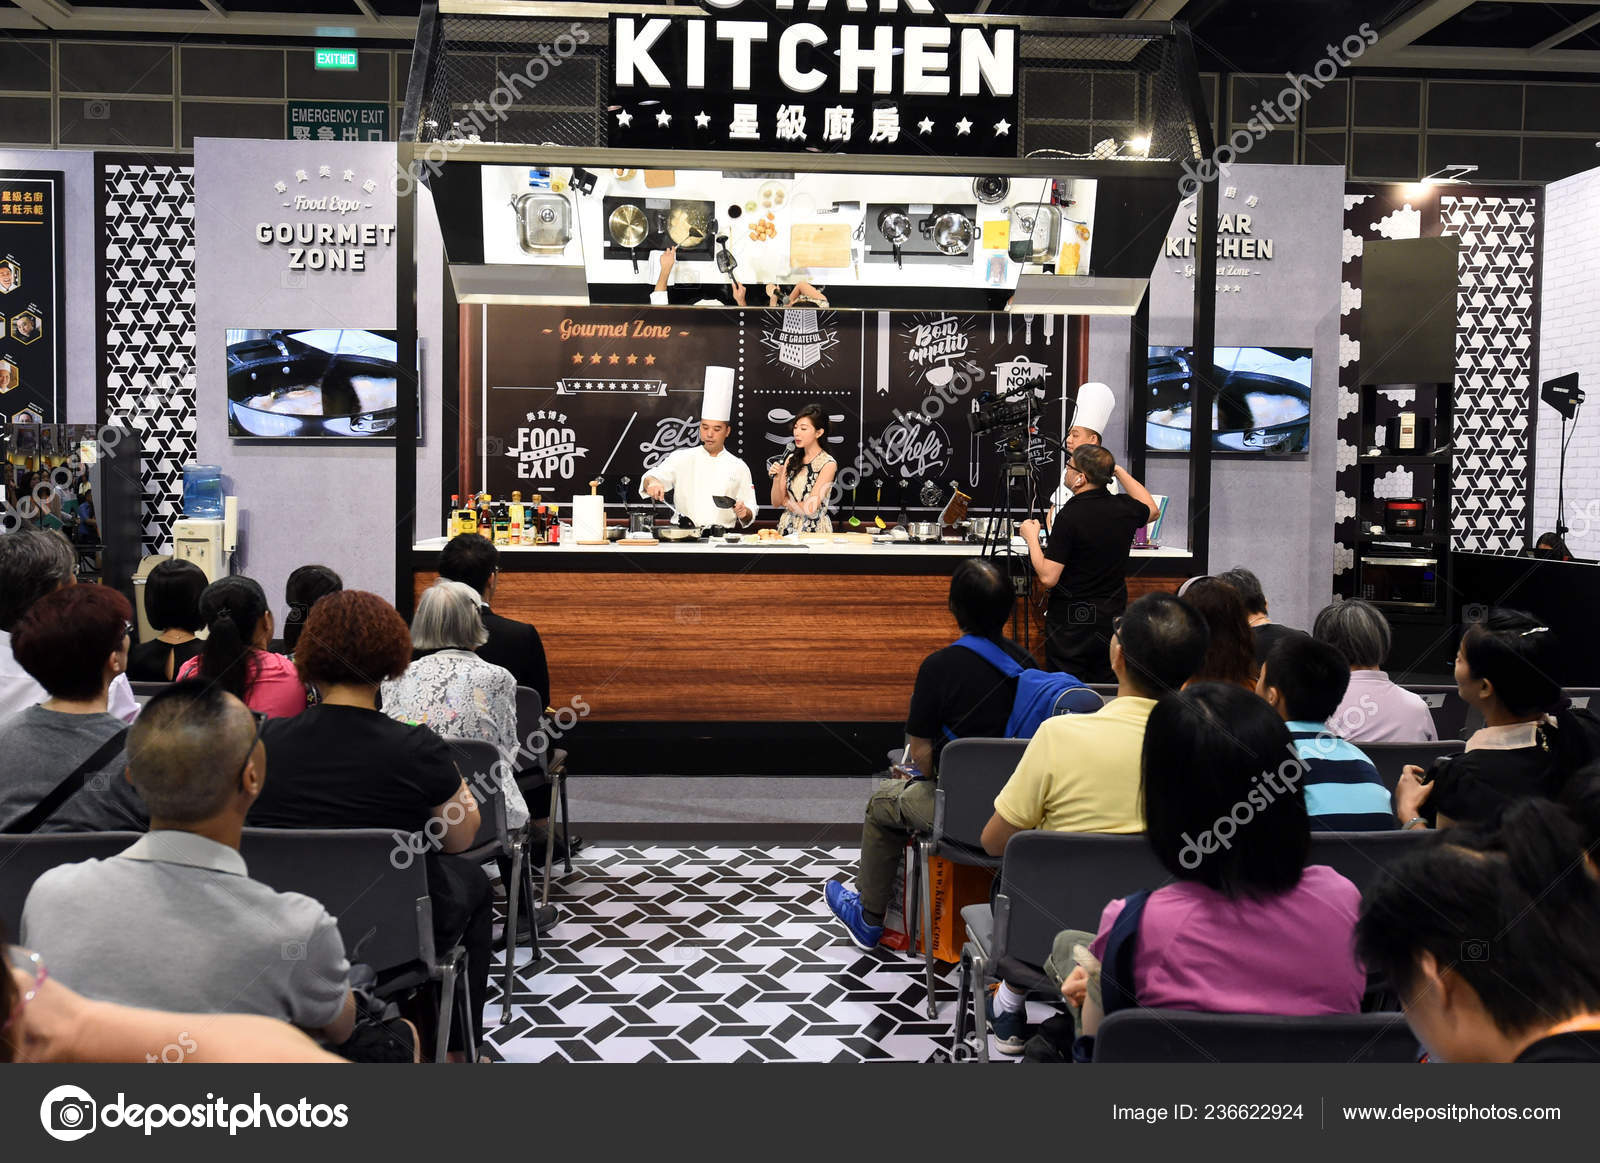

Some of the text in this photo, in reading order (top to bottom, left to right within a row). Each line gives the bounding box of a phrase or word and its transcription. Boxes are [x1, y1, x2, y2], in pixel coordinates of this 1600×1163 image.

[317, 53, 339, 64] EXIT
[615, 17, 1015, 97] KITCHEN
[292, 108, 384, 124] EMERGENCY EXIT
[729, 103, 900, 144] 星級廚房
[294, 195, 361, 215] Food Expo
[255, 222, 396, 246] GOURMET
[1188, 213, 1252, 234] SAR
[287, 247, 365, 271] ZONE
[1166, 236, 1273, 259] KIHEN
[560, 319, 672, 340] Gourmet Zone
[780, 332, 822, 344] BE GRATEFUL
[909, 321, 959, 347] Bon
[1011, 366, 1031, 377] OM
[898, 412, 932, 423] STAR
[517, 427, 576, 452] FOOD
[886, 423, 943, 477] Chefs
[517, 456, 575, 479] EXPO
